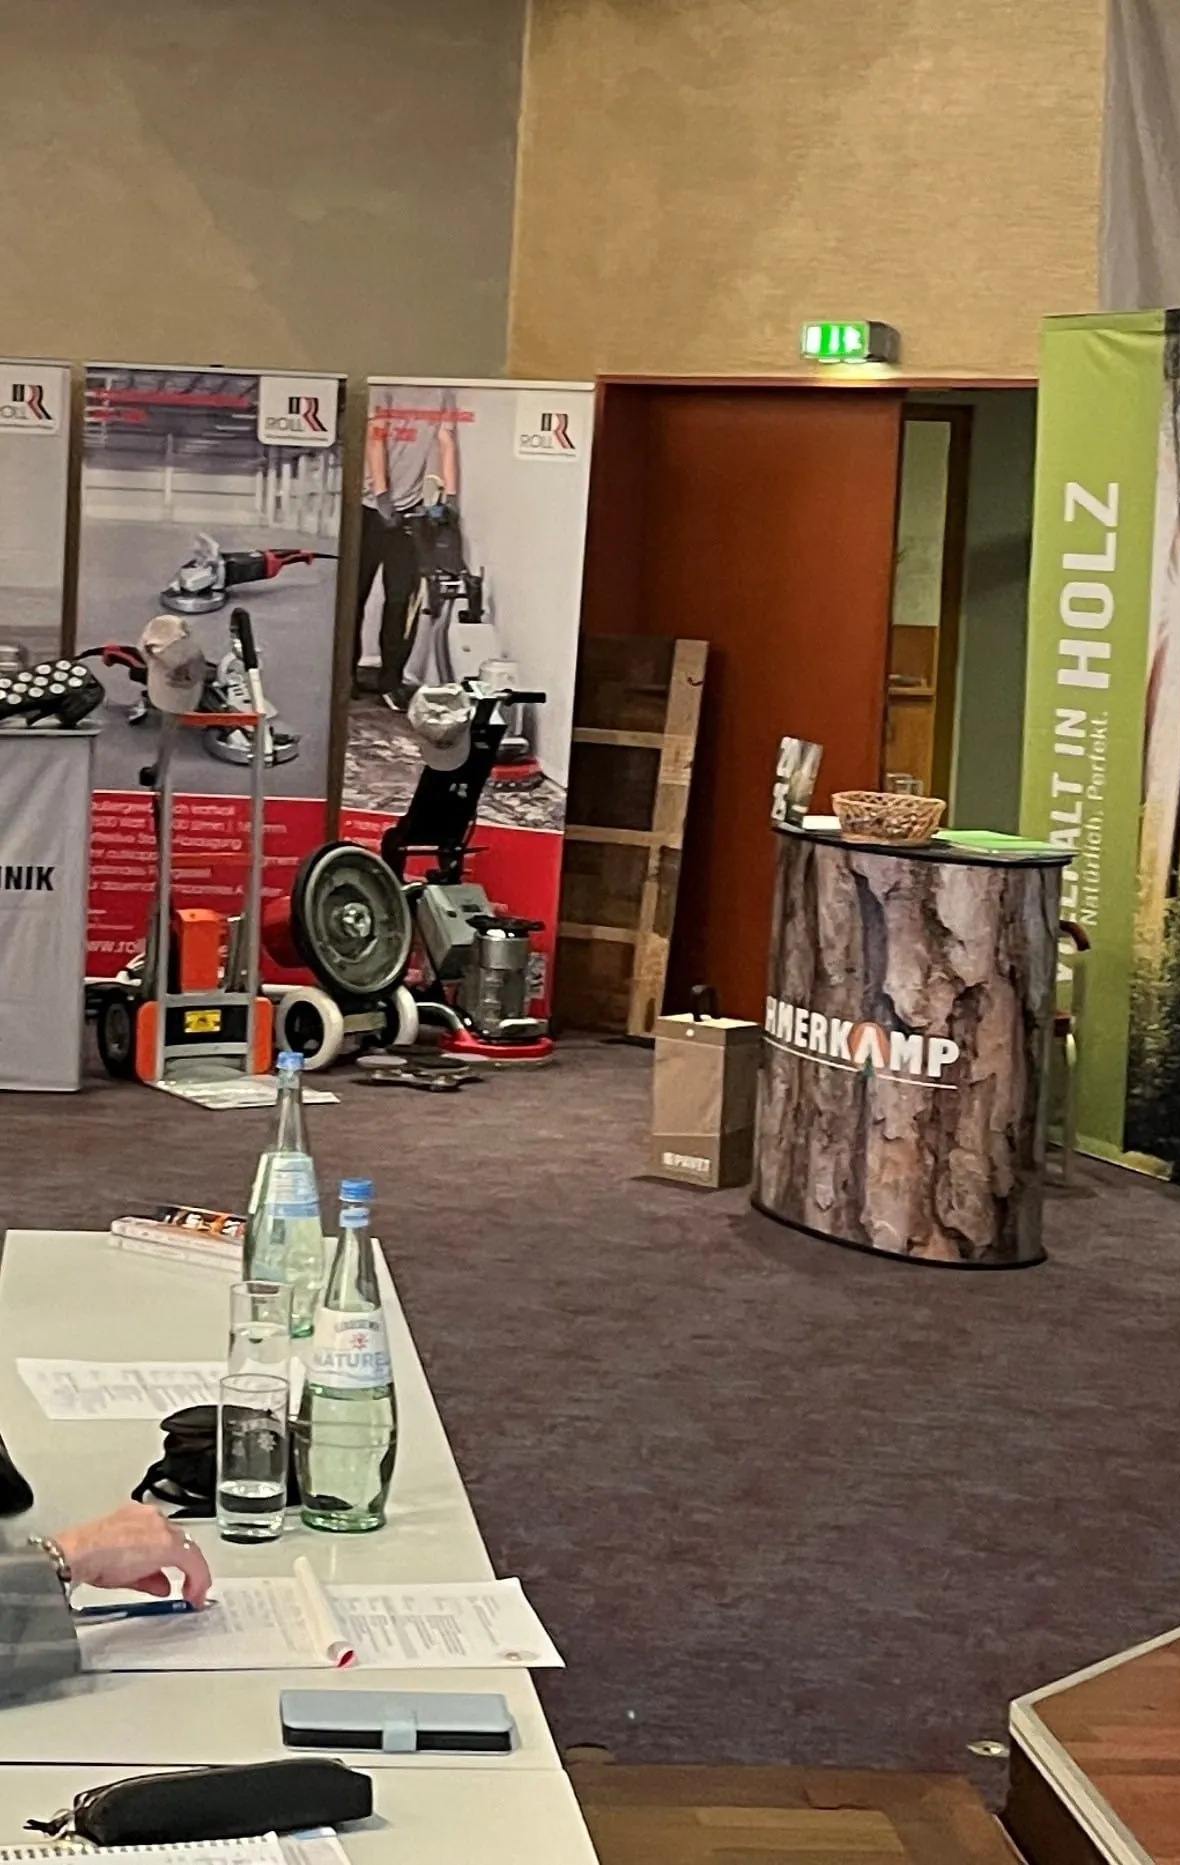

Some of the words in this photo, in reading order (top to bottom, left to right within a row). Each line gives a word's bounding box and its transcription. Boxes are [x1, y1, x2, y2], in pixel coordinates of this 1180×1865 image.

[1057, 482, 1119, 689] HOLZ
[1053, 708, 1088, 757] IN
[0, 866, 56, 891] NIK
[765, 995, 960, 1078] HMERKAMP
